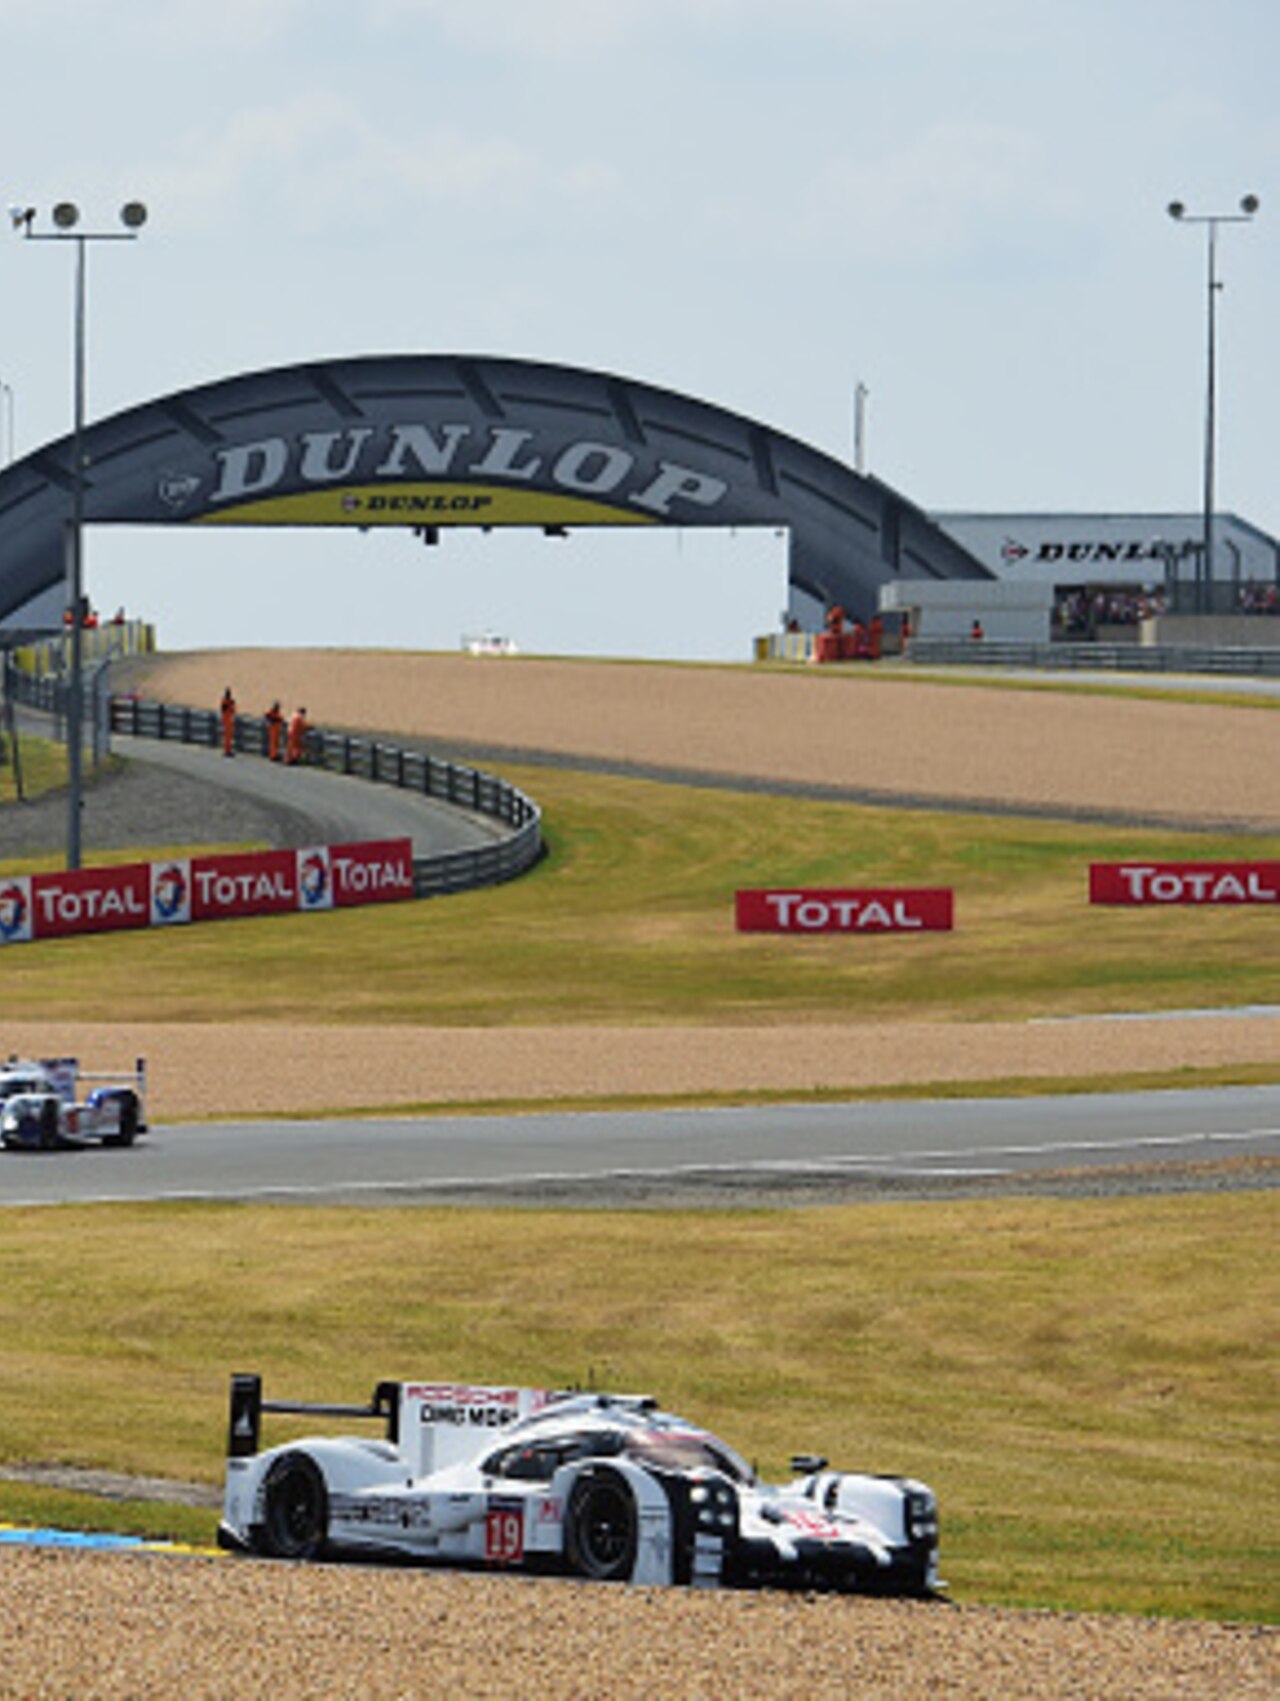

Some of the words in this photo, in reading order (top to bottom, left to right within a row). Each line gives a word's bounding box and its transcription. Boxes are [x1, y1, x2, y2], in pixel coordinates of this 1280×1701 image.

[209, 423, 729, 513] DUNLOP
[366, 494, 493, 512] DUNLOP
[195, 870, 294, 904] TOTAL
[335, 857, 412, 890] TOTAL
[1120, 866, 1277, 900] TOTAL
[36, 886, 144, 922] TOTAL
[766, 893, 923, 928] TOTAL
[490, 1516, 520, 1555] 19
